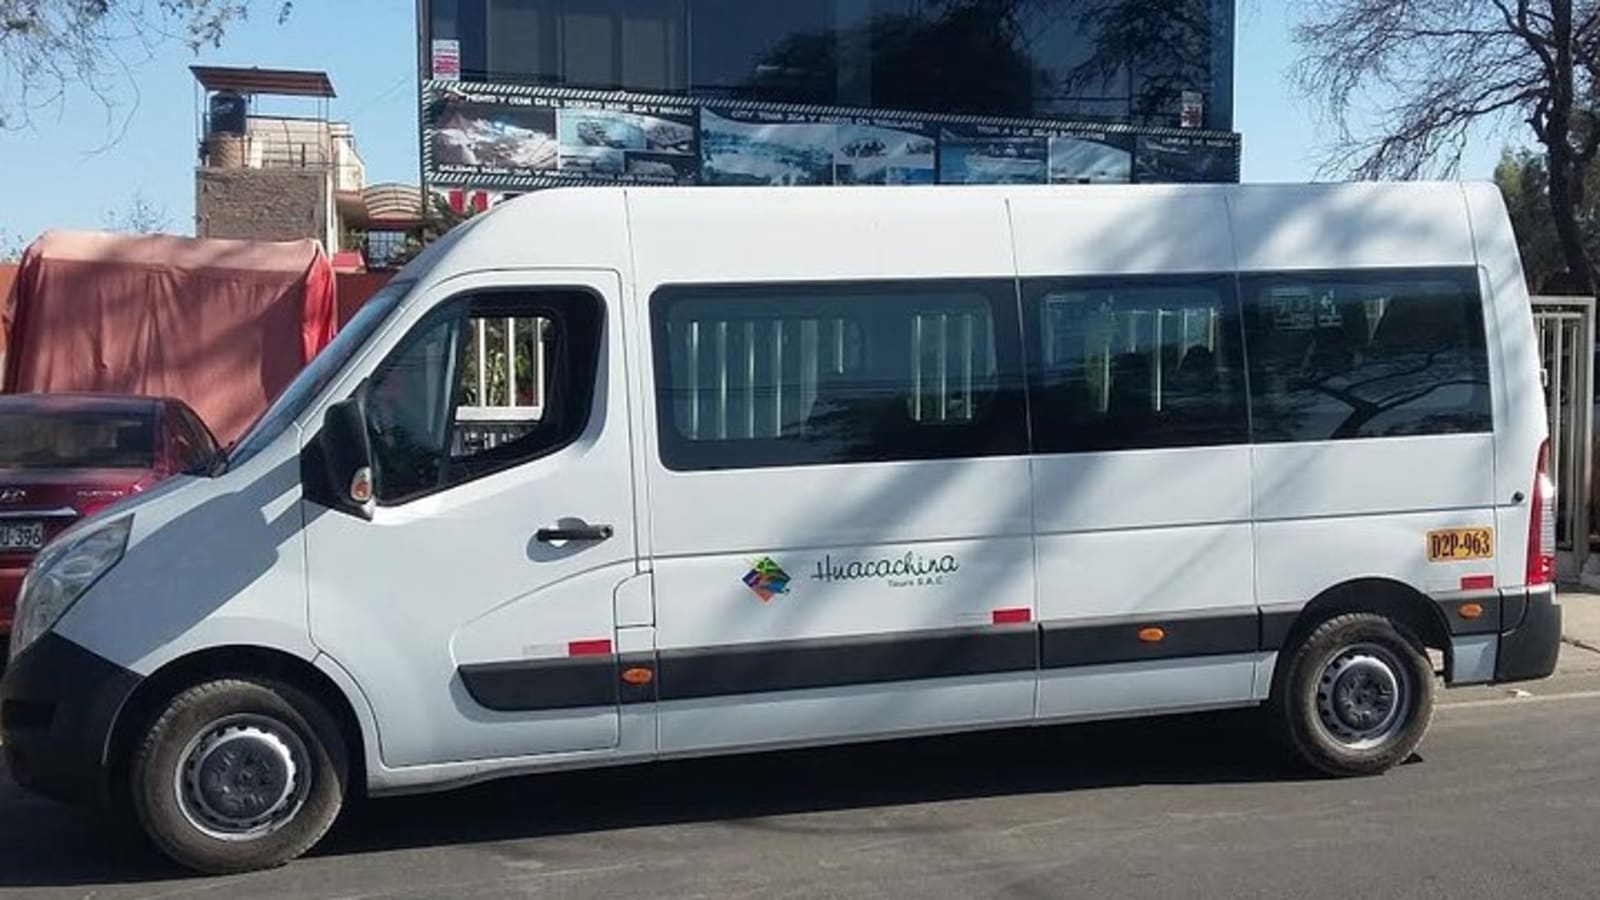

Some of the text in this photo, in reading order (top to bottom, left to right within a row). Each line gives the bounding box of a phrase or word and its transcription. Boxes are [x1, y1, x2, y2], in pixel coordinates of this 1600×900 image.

[730, 109, 754, 119] CITY
[1430, 529, 1490, 560] D2P-963
[810, 550, 960, 583] Huacachina
